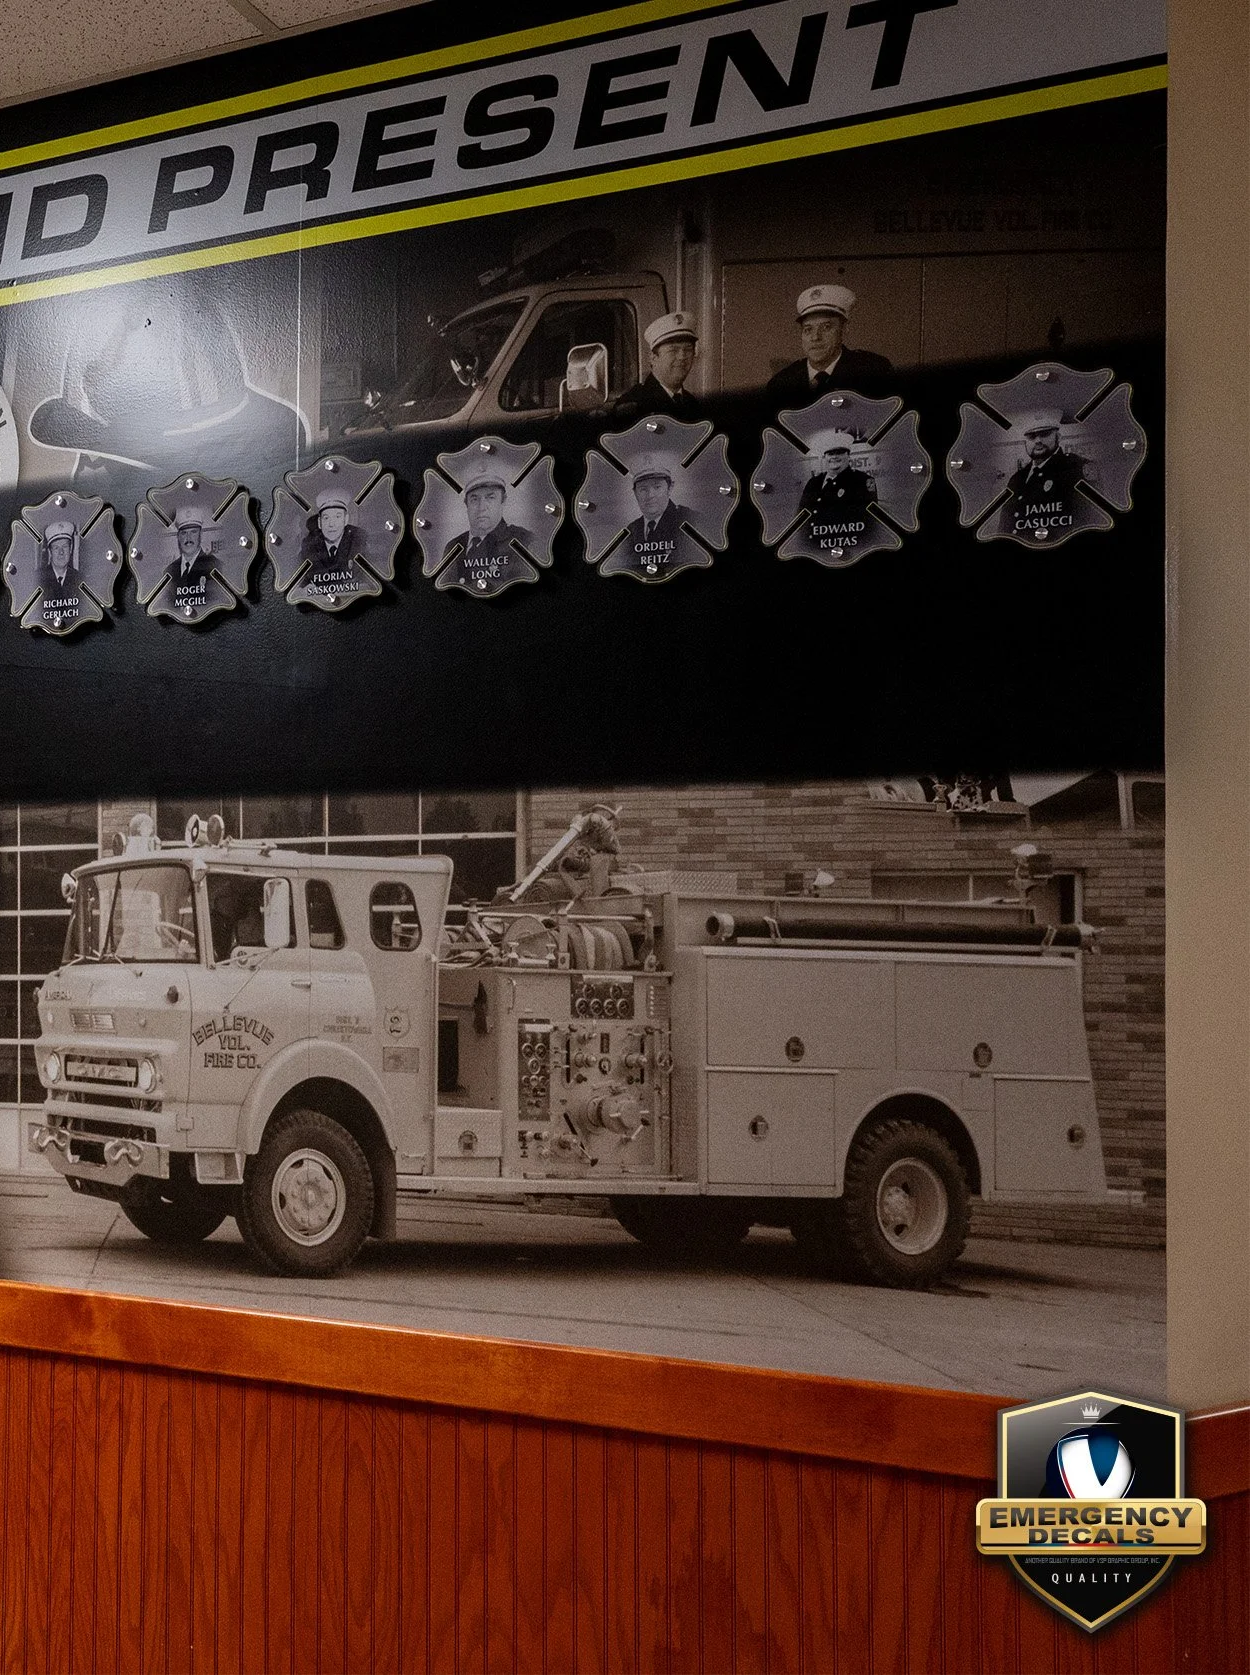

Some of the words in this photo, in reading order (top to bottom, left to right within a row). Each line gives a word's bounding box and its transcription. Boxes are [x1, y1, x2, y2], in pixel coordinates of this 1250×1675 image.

[149, 0, 959, 233] PRESENT
[1025, 502, 1063, 516] JAMIE
[812, 521, 865, 536] EDWARD
[1015, 515, 1073, 530] CASUCCI
[634, 540, 676, 552] ORDELL
[820, 536, 858, 549] KUTAS
[463, 556, 509, 568] WALLACE
[640, 554, 670, 565] REITZ
[313, 571, 353, 583] FLORIAN
[471, 569, 501, 580] LONG
[176, 585, 206, 595] ROGER
[43, 598, 79, 608] RICHARD
[174, 597, 207, 607] MCGILL
[43, 609, 79, 619] GERLACH
[192, 1015, 275, 1046] BELLEVUE
[218, 1034, 250, 1051] VOL.
[203, 1053, 235, 1069] FIRE
[236, 1054, 262, 1069] CO.
